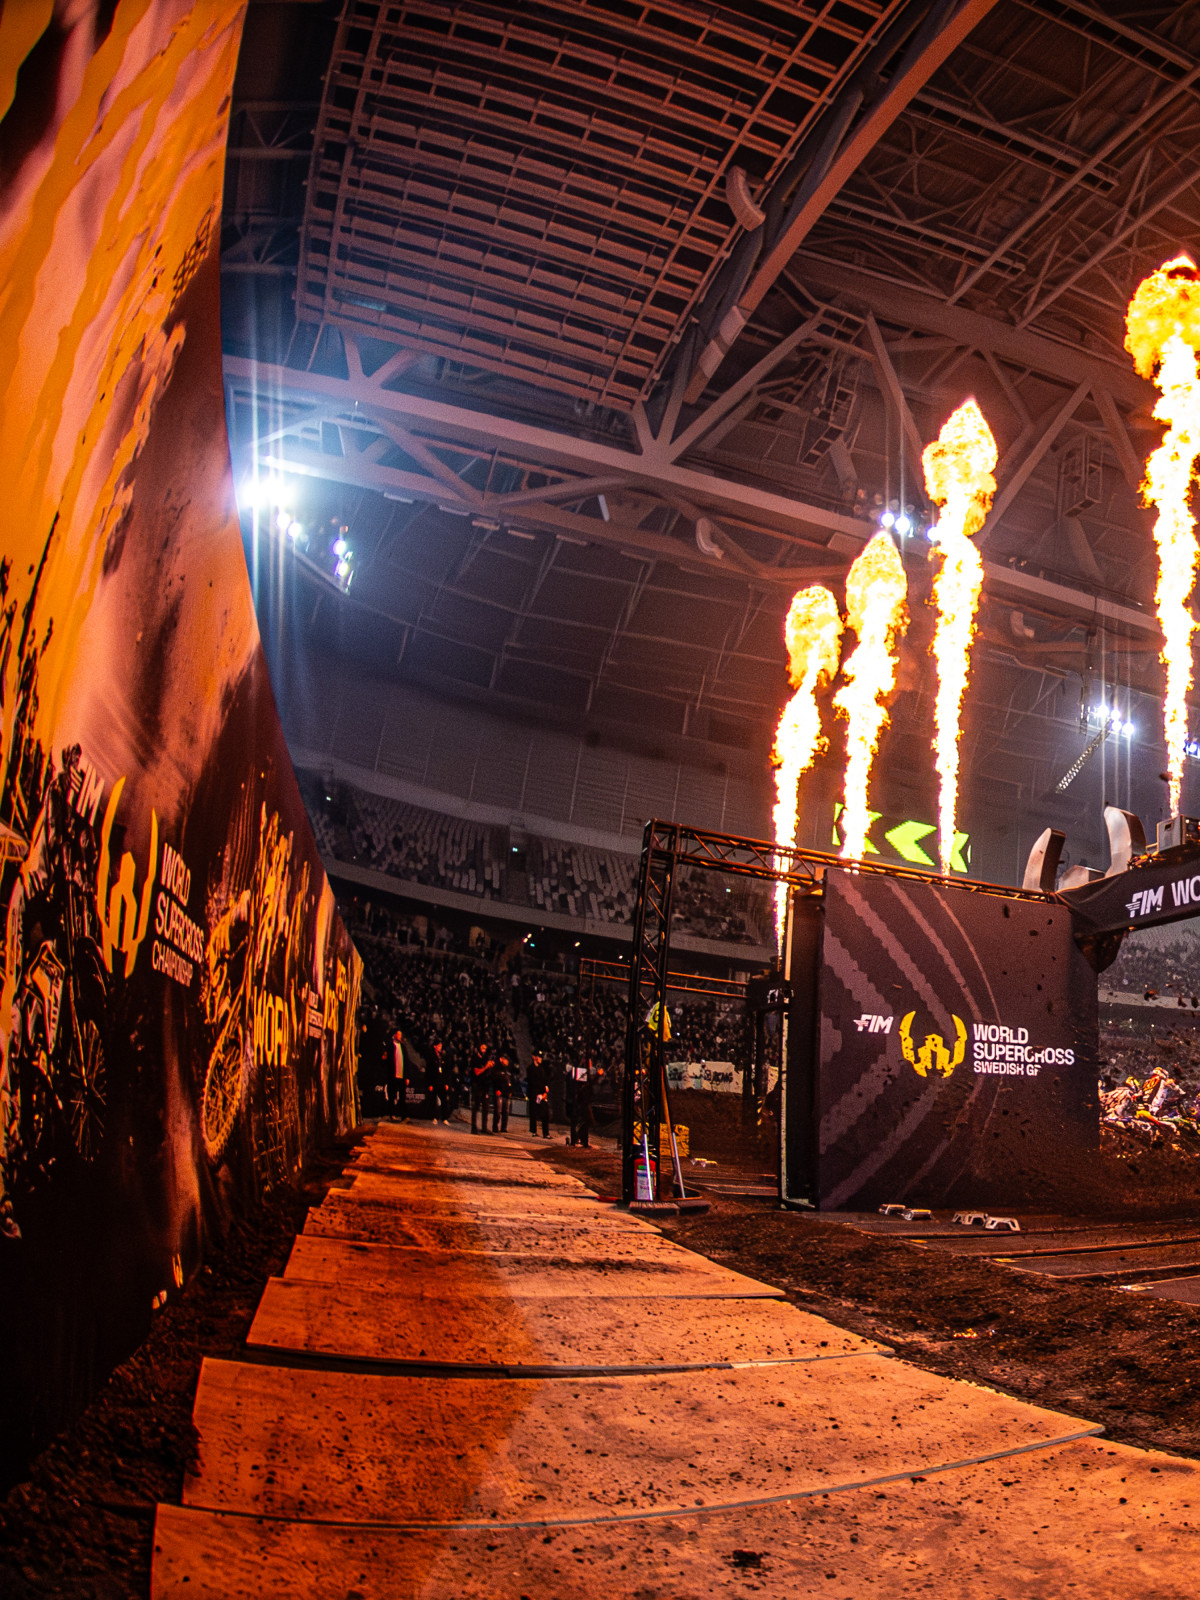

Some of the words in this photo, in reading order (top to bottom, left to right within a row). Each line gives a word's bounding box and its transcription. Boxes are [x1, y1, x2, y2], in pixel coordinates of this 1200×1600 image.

[161, 842, 191, 907] WORLD
[1125, 885, 1165, 918] FIM
[155, 891, 205, 964] SUPERCROSS
[853, 1014, 894, 1034] FIM
[973, 1023, 1029, 1044] WORLD
[973, 1043, 1075, 1065] SUPERCROSS
[973, 1061, 1025, 1076] SWEDISH
